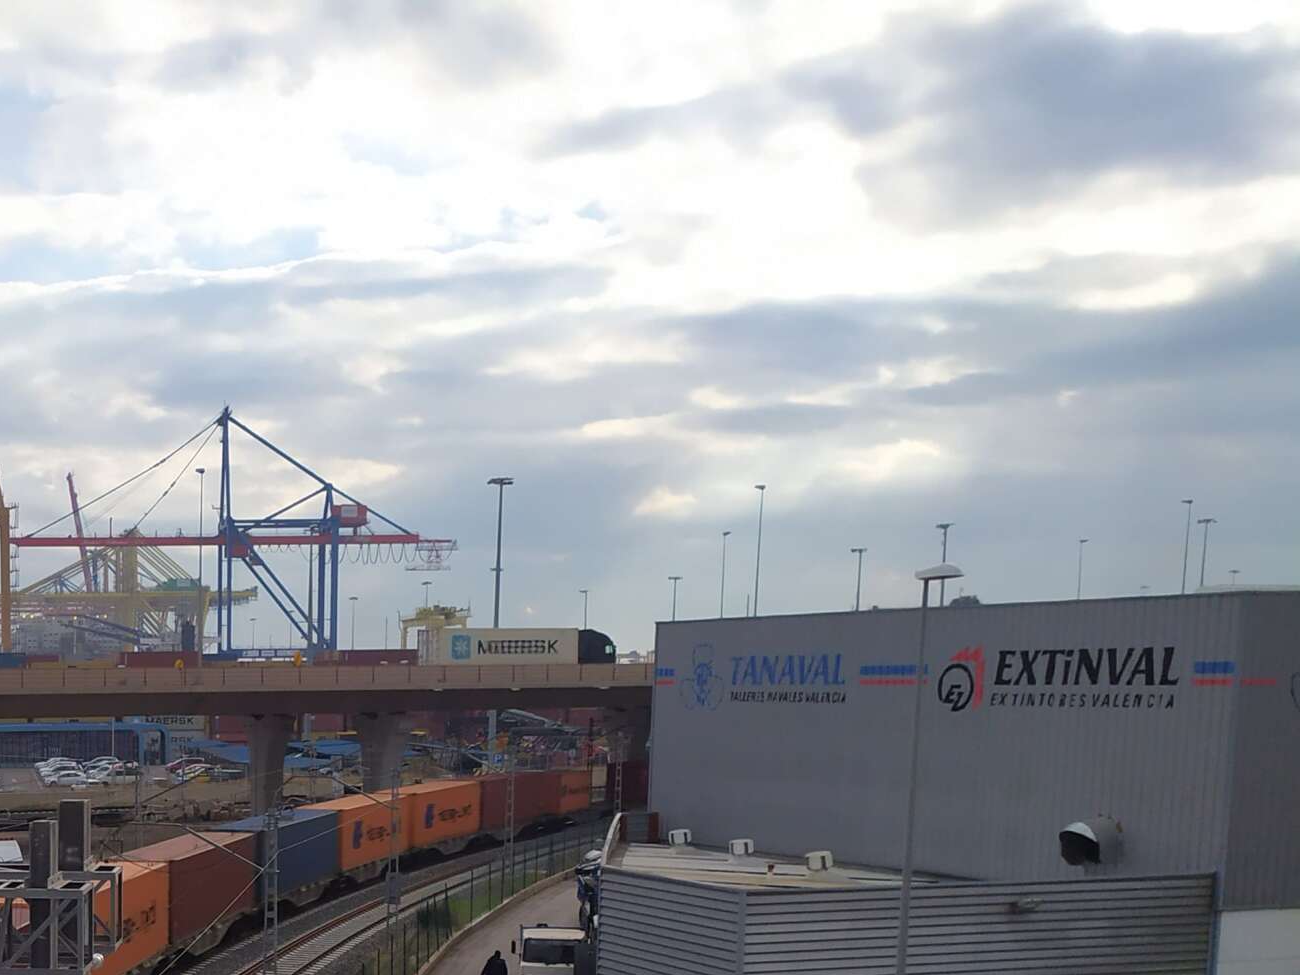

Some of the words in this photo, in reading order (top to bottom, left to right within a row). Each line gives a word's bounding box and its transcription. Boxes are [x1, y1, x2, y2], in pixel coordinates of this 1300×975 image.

[730, 653, 846, 686] TANAVAL
[730, 690, 765, 703] TALLERES
[767, 690, 803, 704] NAVALES
[804, 690, 847, 704] VALENCIA
[989, 692, 1086, 709] EXTINTORES
[1091, 692, 1175, 710] VALENCIA
